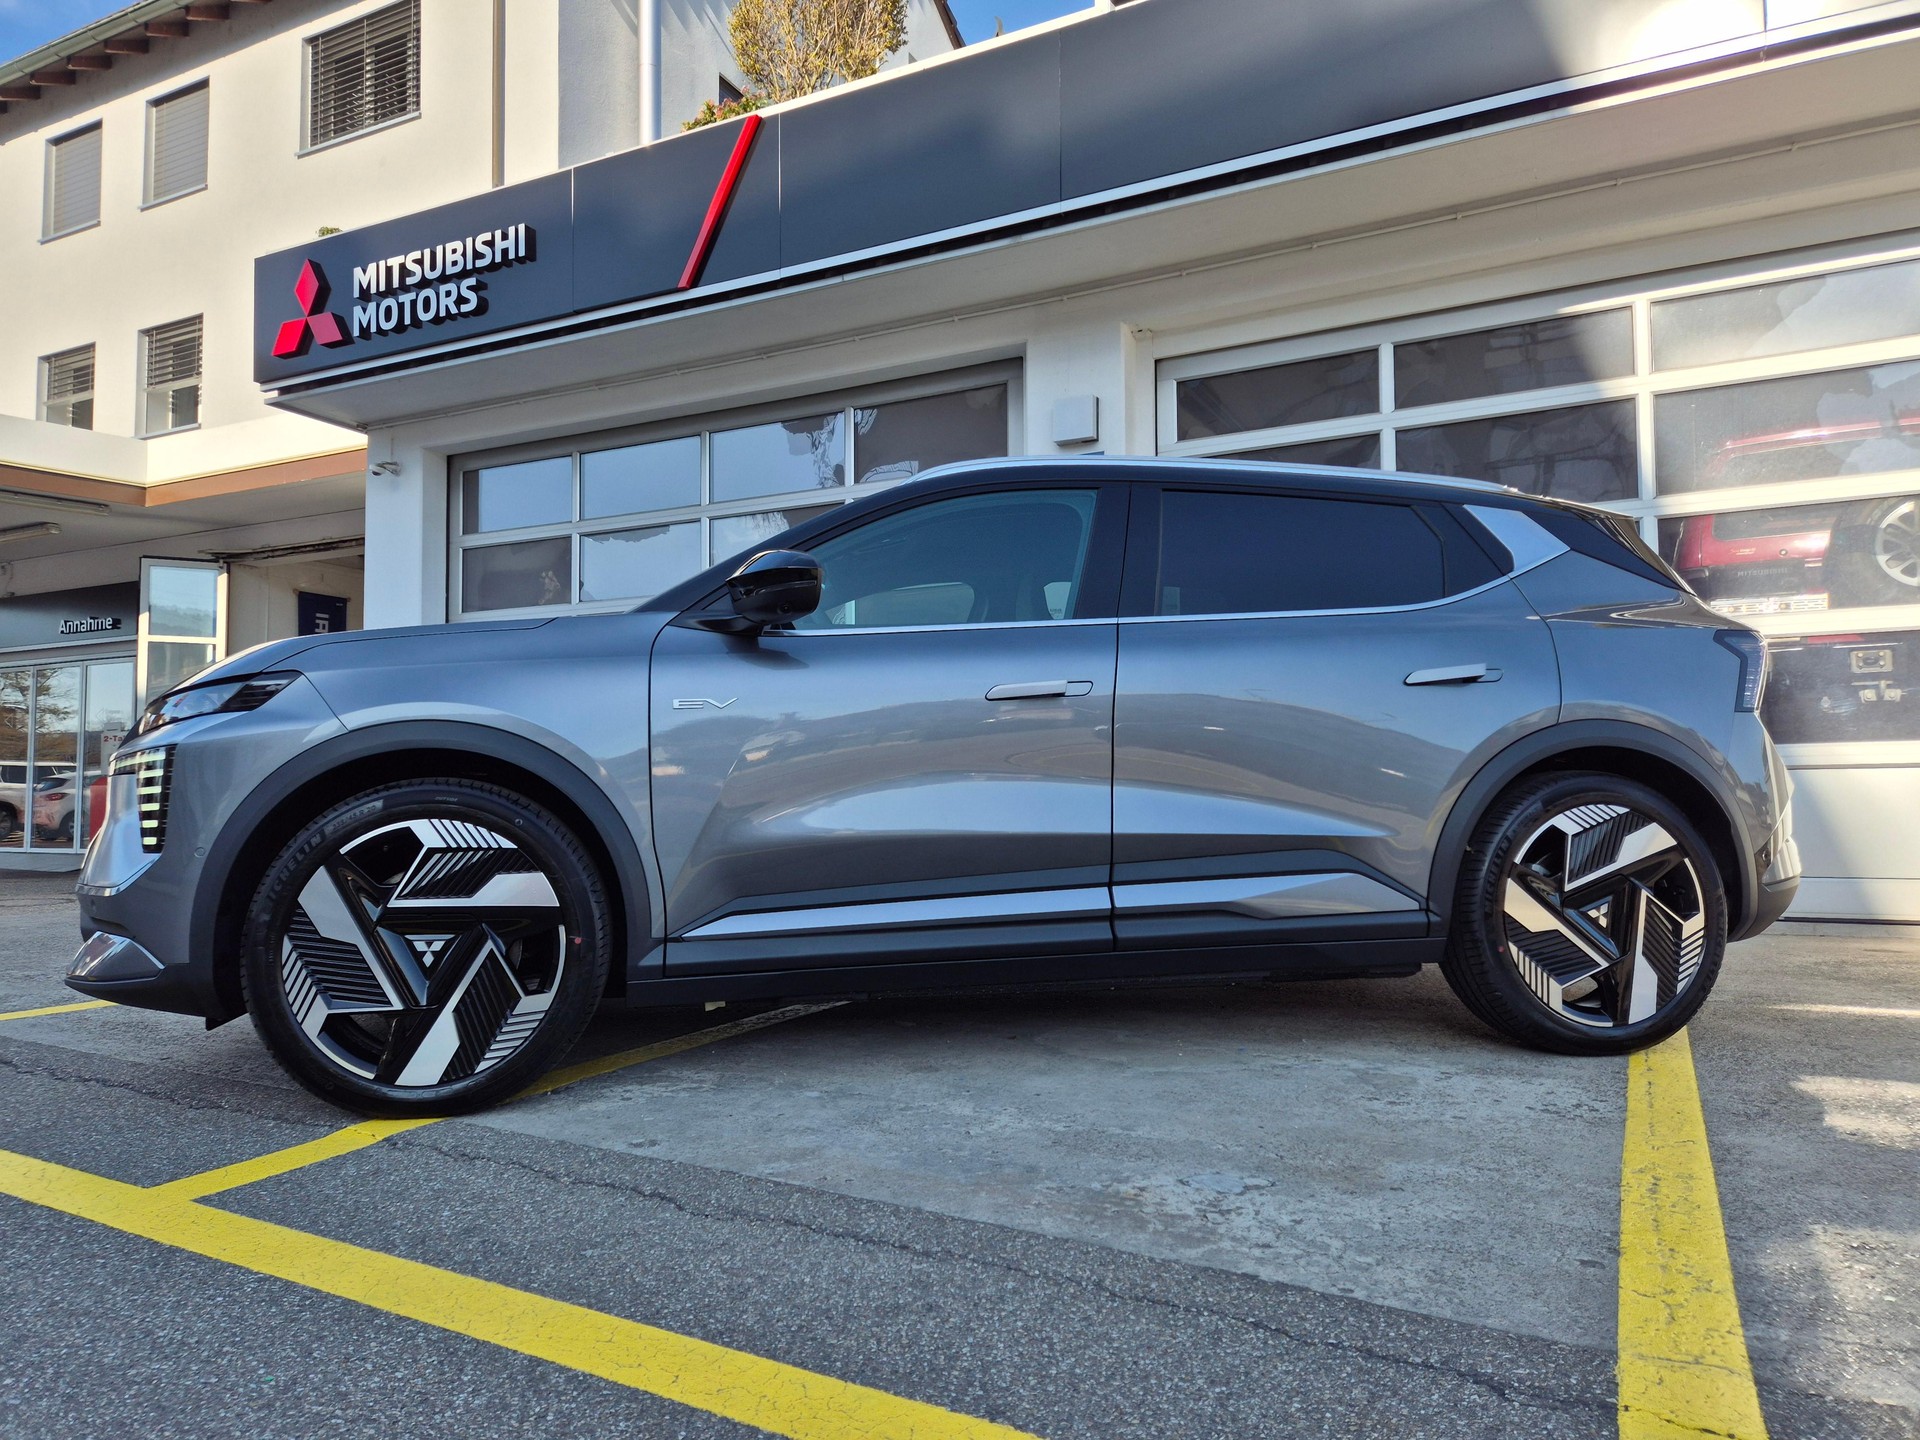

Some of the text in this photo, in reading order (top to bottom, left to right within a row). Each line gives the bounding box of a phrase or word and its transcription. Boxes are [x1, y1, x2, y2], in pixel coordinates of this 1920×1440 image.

[353, 223, 526, 298] MITSUBISHI
[353, 277, 478, 337] MOTORS
[58, 616, 113, 635] Annahme
[672, 698, 738, 710] EV
